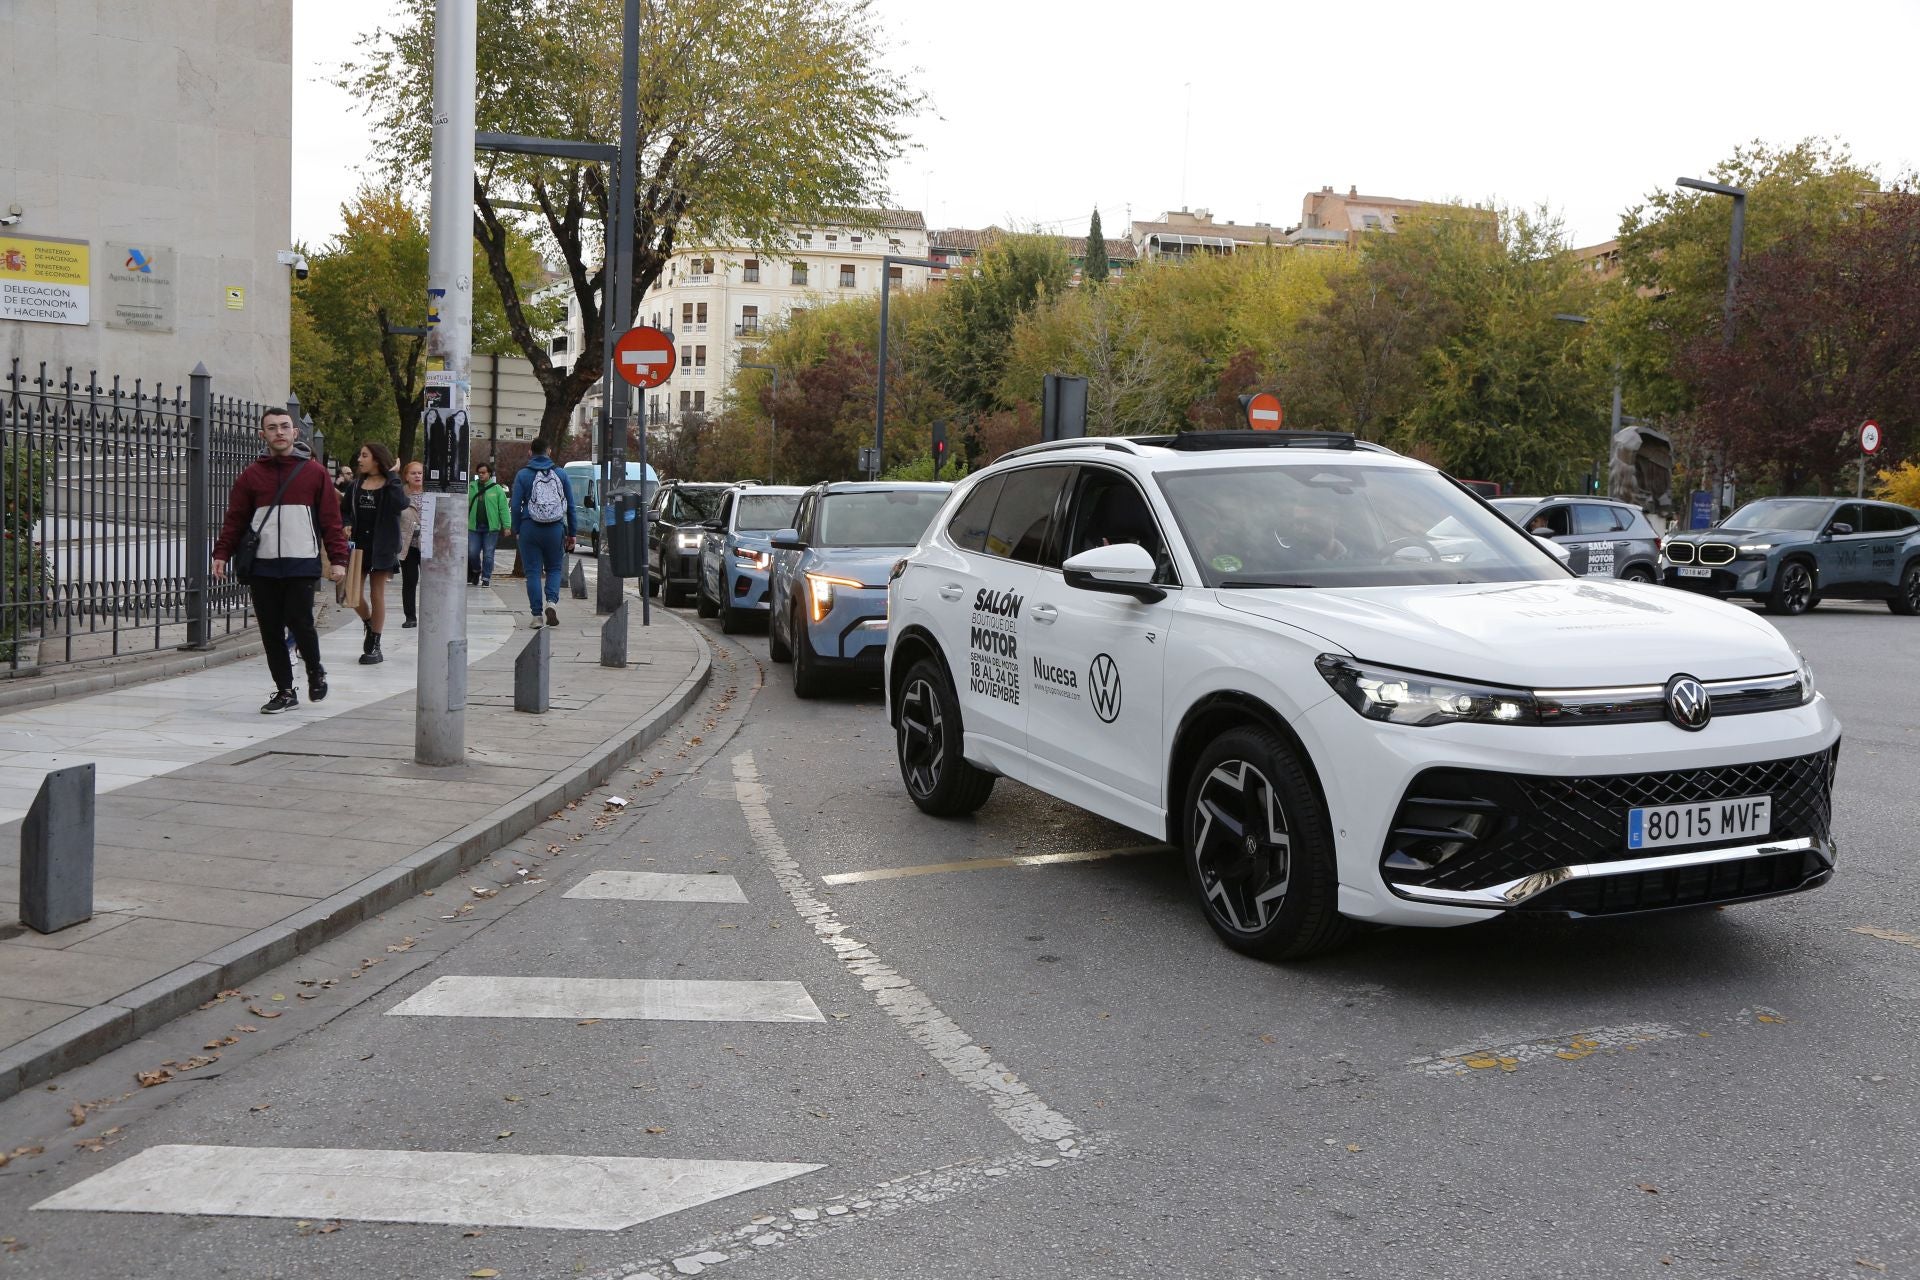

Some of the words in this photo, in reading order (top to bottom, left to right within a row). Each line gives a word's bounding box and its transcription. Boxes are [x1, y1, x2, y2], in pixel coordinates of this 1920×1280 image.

[34, 247, 70, 256] MINISTERIO
[45, 255, 78, 263] HACIENDA
[34, 263, 70, 272] MINISTERIO
[45, 270, 81, 279] ECONOMÍA
[4, 284, 70, 298] DELEGACIÓN
[4, 295, 18, 304] DE
[21, 297, 78, 309] ECONOMÍA
[5, 306, 11, 315] Y
[14, 308, 67, 319] HACIENDA
[1588, 540, 1614, 550] SALÓN
[1588, 555, 1614, 563] MOTOR
[974, 587, 1024, 618] SALÓN
[972, 612, 1004, 630] BOUTIQUE
[1004, 618, 1017, 633] DEL
[970, 626, 1018, 660] MOTOR
[970, 652, 992, 665] SEMANA
[992, 657, 1002, 667] DEL
[1002, 660, 1019, 673] MOTOR
[970, 661, 980, 678] 18
[982, 664, 995, 681] AL
[995, 668, 1006, 685] 24
[1007, 671, 1020, 690] DE
[1033, 656, 1078, 689] Nucesa
[970, 677, 1020, 706] NOVIEMBRE
[1647, 807, 1712, 841] 8015
[1720, 801, 1765, 835] MVF
